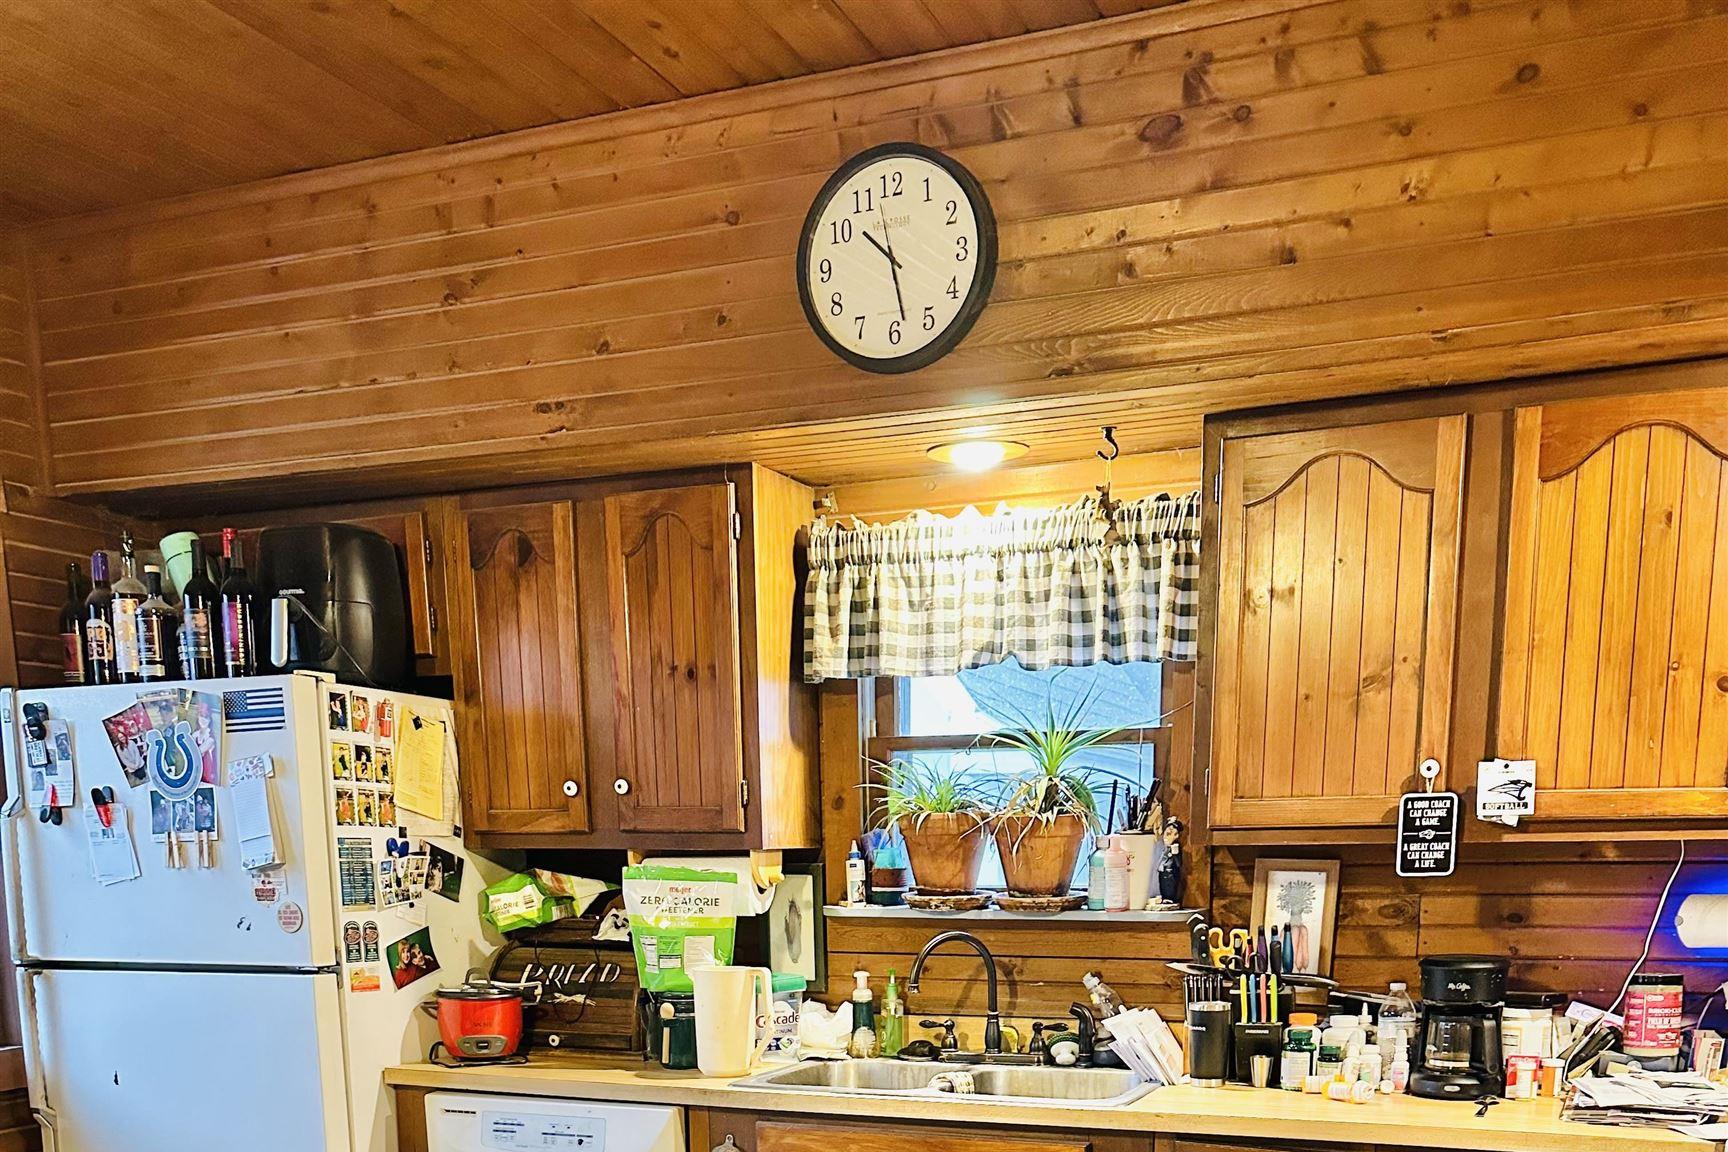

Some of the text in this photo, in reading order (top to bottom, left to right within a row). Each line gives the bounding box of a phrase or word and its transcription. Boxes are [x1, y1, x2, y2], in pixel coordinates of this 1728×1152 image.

[880, 171, 903, 199] 12
[923, 178, 932, 202] 1
[853, 188, 874, 214] 11
[945, 200, 957, 225] 2
[830, 218, 852, 245] 10
[956, 236, 968, 261] 3
[820, 259, 832, 283] 9
[946, 275, 959, 299] 4
[831, 292, 843, 316] 8
[855, 316, 866, 340] 7
[923, 306, 935, 330] 5
[889, 320, 901, 344] 6
[1407, 800, 1451, 809] A GOOD COACH
[1410, 809, 1447, 817] CAN CHANGE
[1485, 802, 1525, 810] SOFTBALL
[1415, 818, 1420, 826] A
[1403, 842, 1450, 851] A GREAT COACH
[1407, 851, 1445, 859] CAN CHANGE
[1415, 860, 1420, 868] A
[756, 1011, 800, 1028] Ccade
